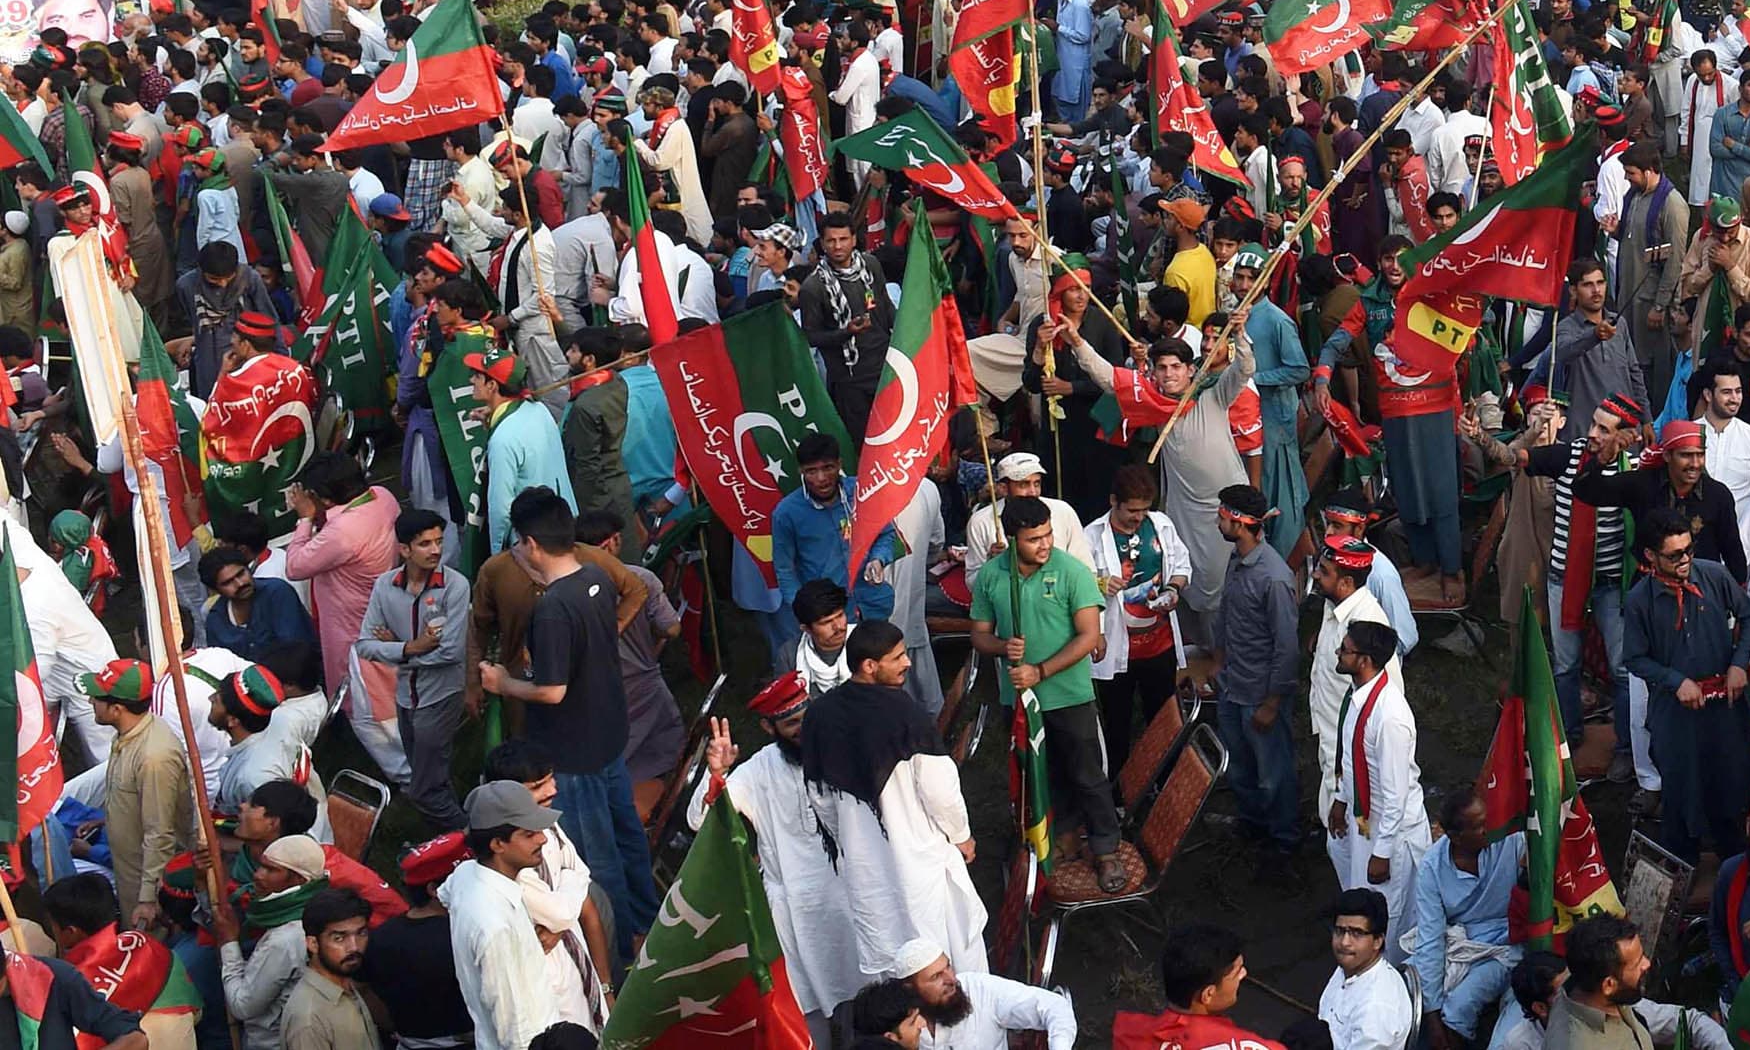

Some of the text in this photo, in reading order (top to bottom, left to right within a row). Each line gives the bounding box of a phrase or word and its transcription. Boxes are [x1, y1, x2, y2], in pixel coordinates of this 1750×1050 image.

[0, 0, 28, 24] 9
[336, 291, 366, 370] PTI
[679, 360, 768, 531] پاکستان تحریک انصاف
